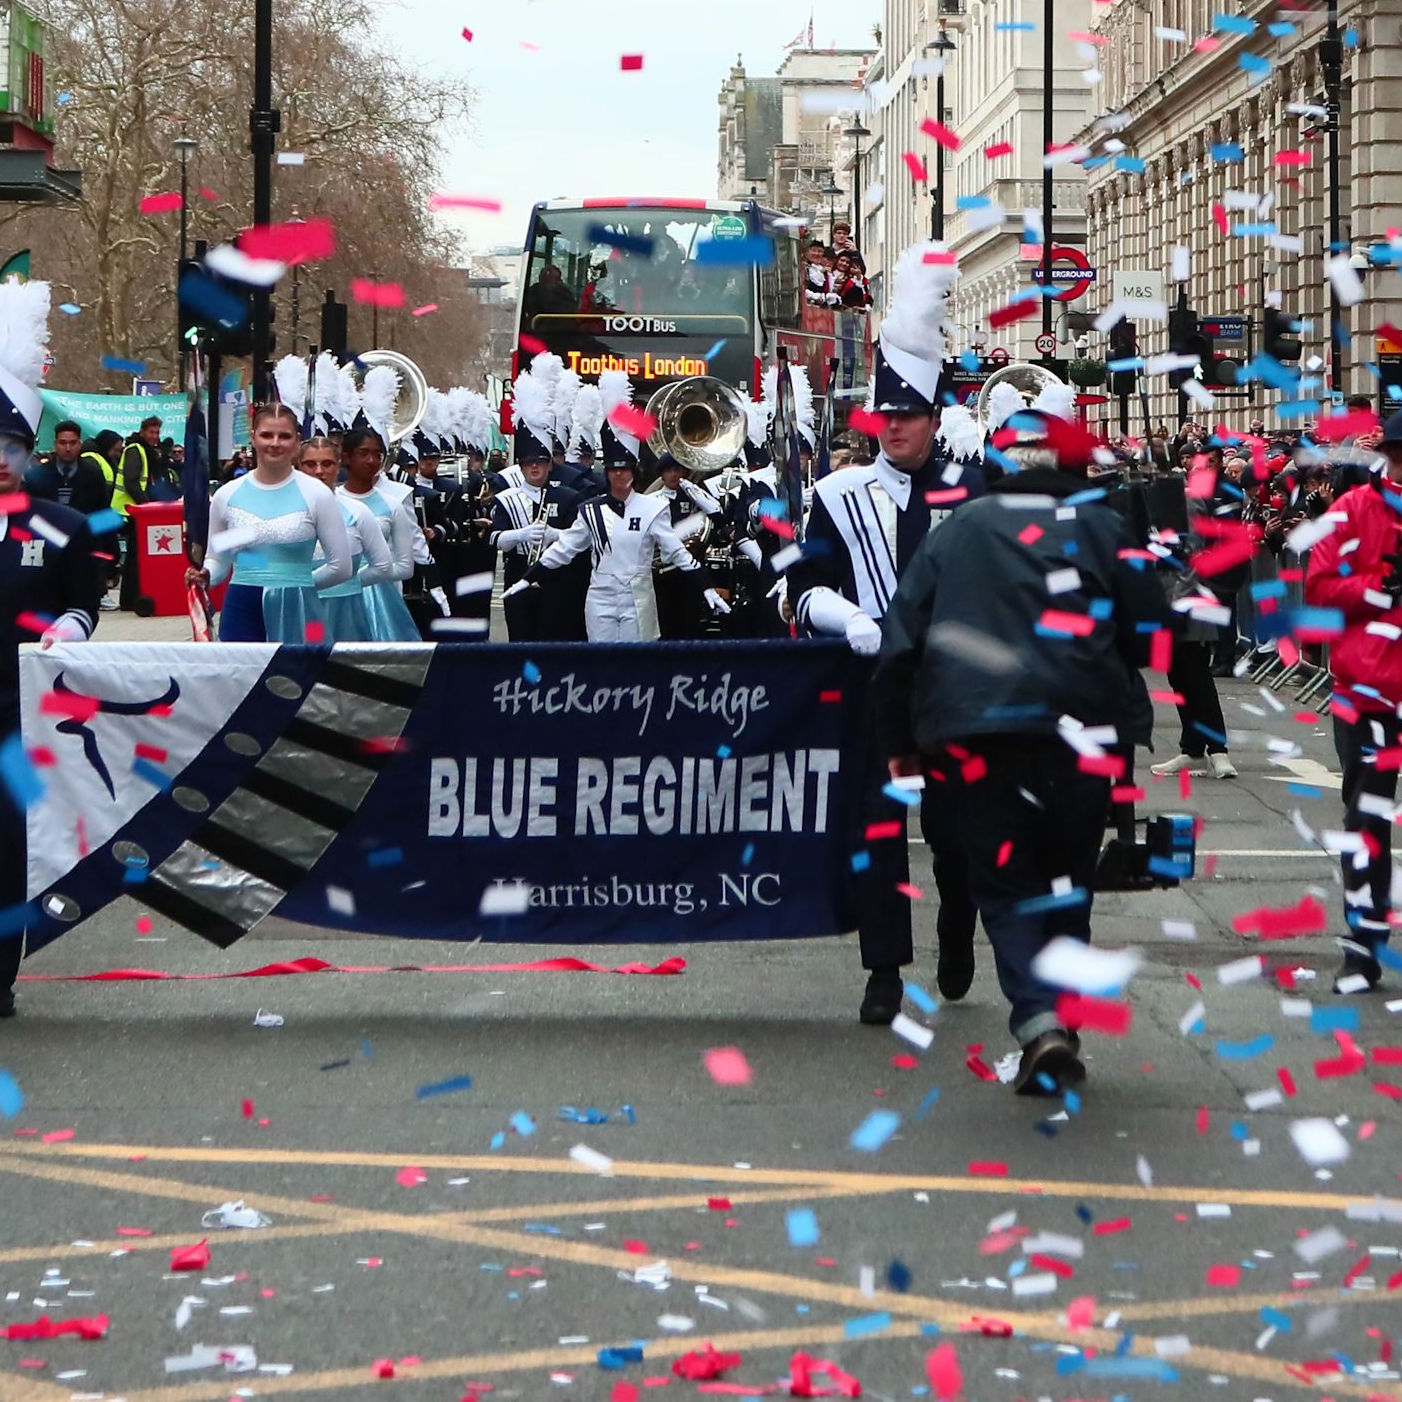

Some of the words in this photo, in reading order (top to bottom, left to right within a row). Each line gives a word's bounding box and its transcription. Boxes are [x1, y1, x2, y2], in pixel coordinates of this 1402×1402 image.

[1035, 270, 1094, 278] UERGROUND
[1123, 286, 1152, 298] M&S
[1040, 339, 1053, 348] 20
[567, 351, 639, 375] Tootbus
[644, 352, 707, 379] London
[59, 396, 83, 409] THE
[85, 401, 121, 411] EARTH
[124, 402, 135, 412] IS
[138, 402, 159, 411] BUT
[163, 401, 185, 411] ONE
[68, 410, 90, 420] AND
[93, 414, 142, 424] MANKIND
[628, 516, 641, 531] H
[21, 539, 45, 567] H
[493, 673, 655, 736] Hickory
[666, 673, 770, 738] Ridge
[428, 756, 559, 839] BLUE
[574, 748, 840, 836] REGIMENT
[493, 875, 708, 916] arrisburg,
[718, 873, 781, 907] NC
